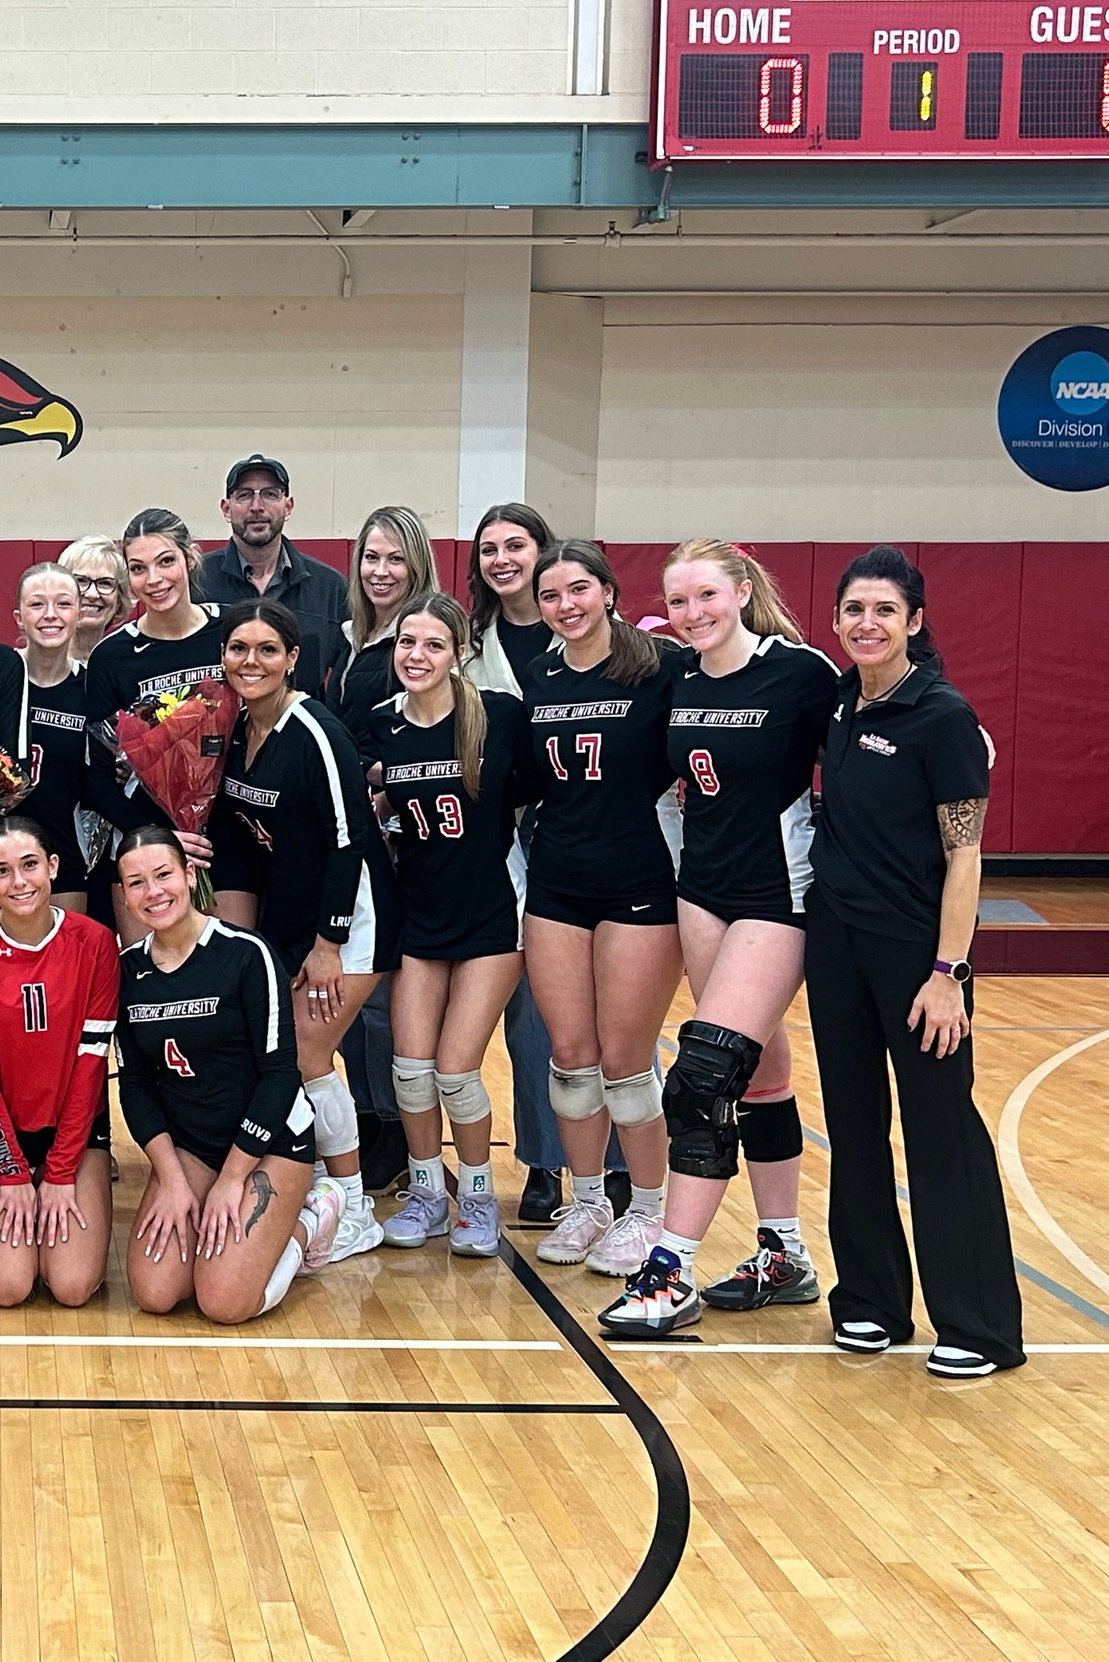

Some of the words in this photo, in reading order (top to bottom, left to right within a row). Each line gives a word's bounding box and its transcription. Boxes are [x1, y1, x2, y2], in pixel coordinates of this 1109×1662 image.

[687, 8, 792, 44] HOME
[873, 29, 961, 55] PERIOD
[758, 57, 804, 135] 0
[919, 69, 934, 122] 1
[1056, 382, 1109, 399] NCAA
[1038, 419, 1103, 437] Division
[1012, 440, 1054, 449] DISCOVER
[1058, 440, 1098, 449] DEVELOP
[154, 673, 182, 691] ROCHE
[184, 667, 223, 683] UNIVERS
[33, 709, 85, 729] UNIVERSITY
[571, 702, 628, 718] UNIVERSITY
[703, 711, 763, 724] UNIVERSITY
[546, 733, 602, 781] 17
[395, 765, 424, 779] ROCHE
[424, 762, 463, 777] UNIVERS
[688, 748, 721, 796] 8
[407, 794, 465, 841] 13
[21, 982, 48, 1033] 11
[162, 1000, 216, 1018] UNIVERSITY
[164, 1038, 196, 1078] 4
